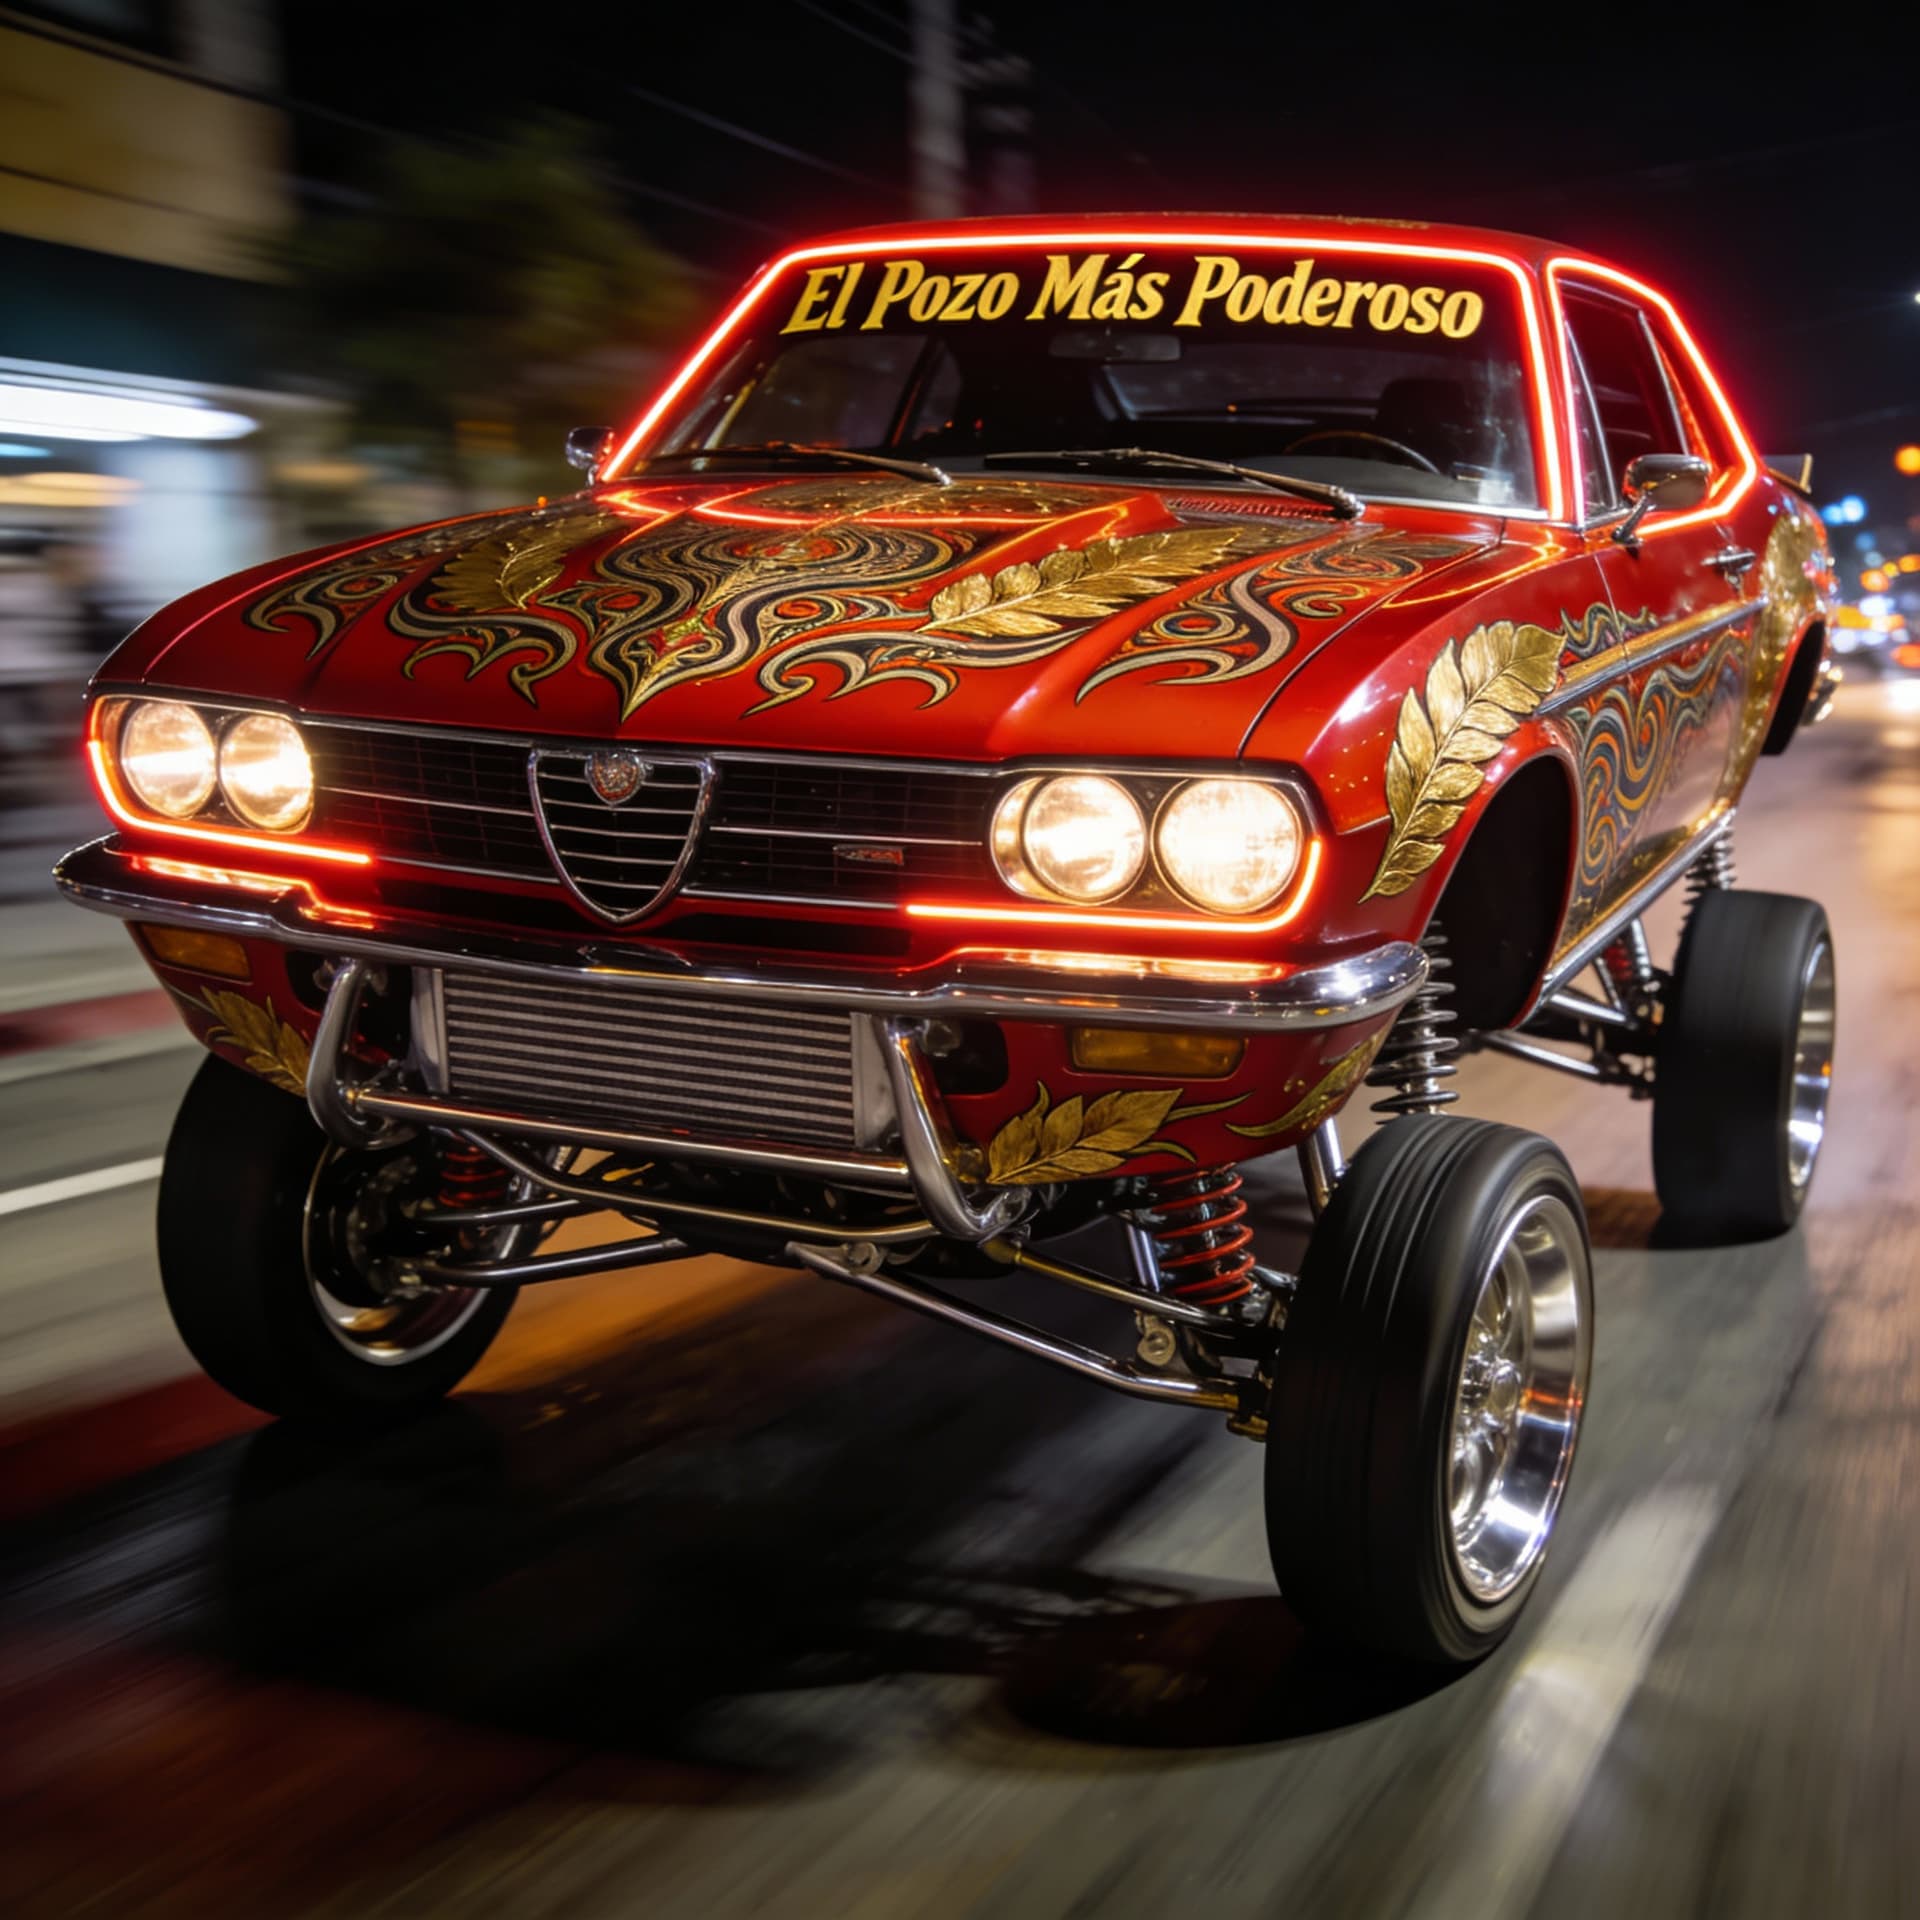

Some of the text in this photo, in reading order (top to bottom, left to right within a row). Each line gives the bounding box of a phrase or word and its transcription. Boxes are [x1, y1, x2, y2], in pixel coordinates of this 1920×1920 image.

[779, 253, 1483, 339] El Pozo Más Poderoso
